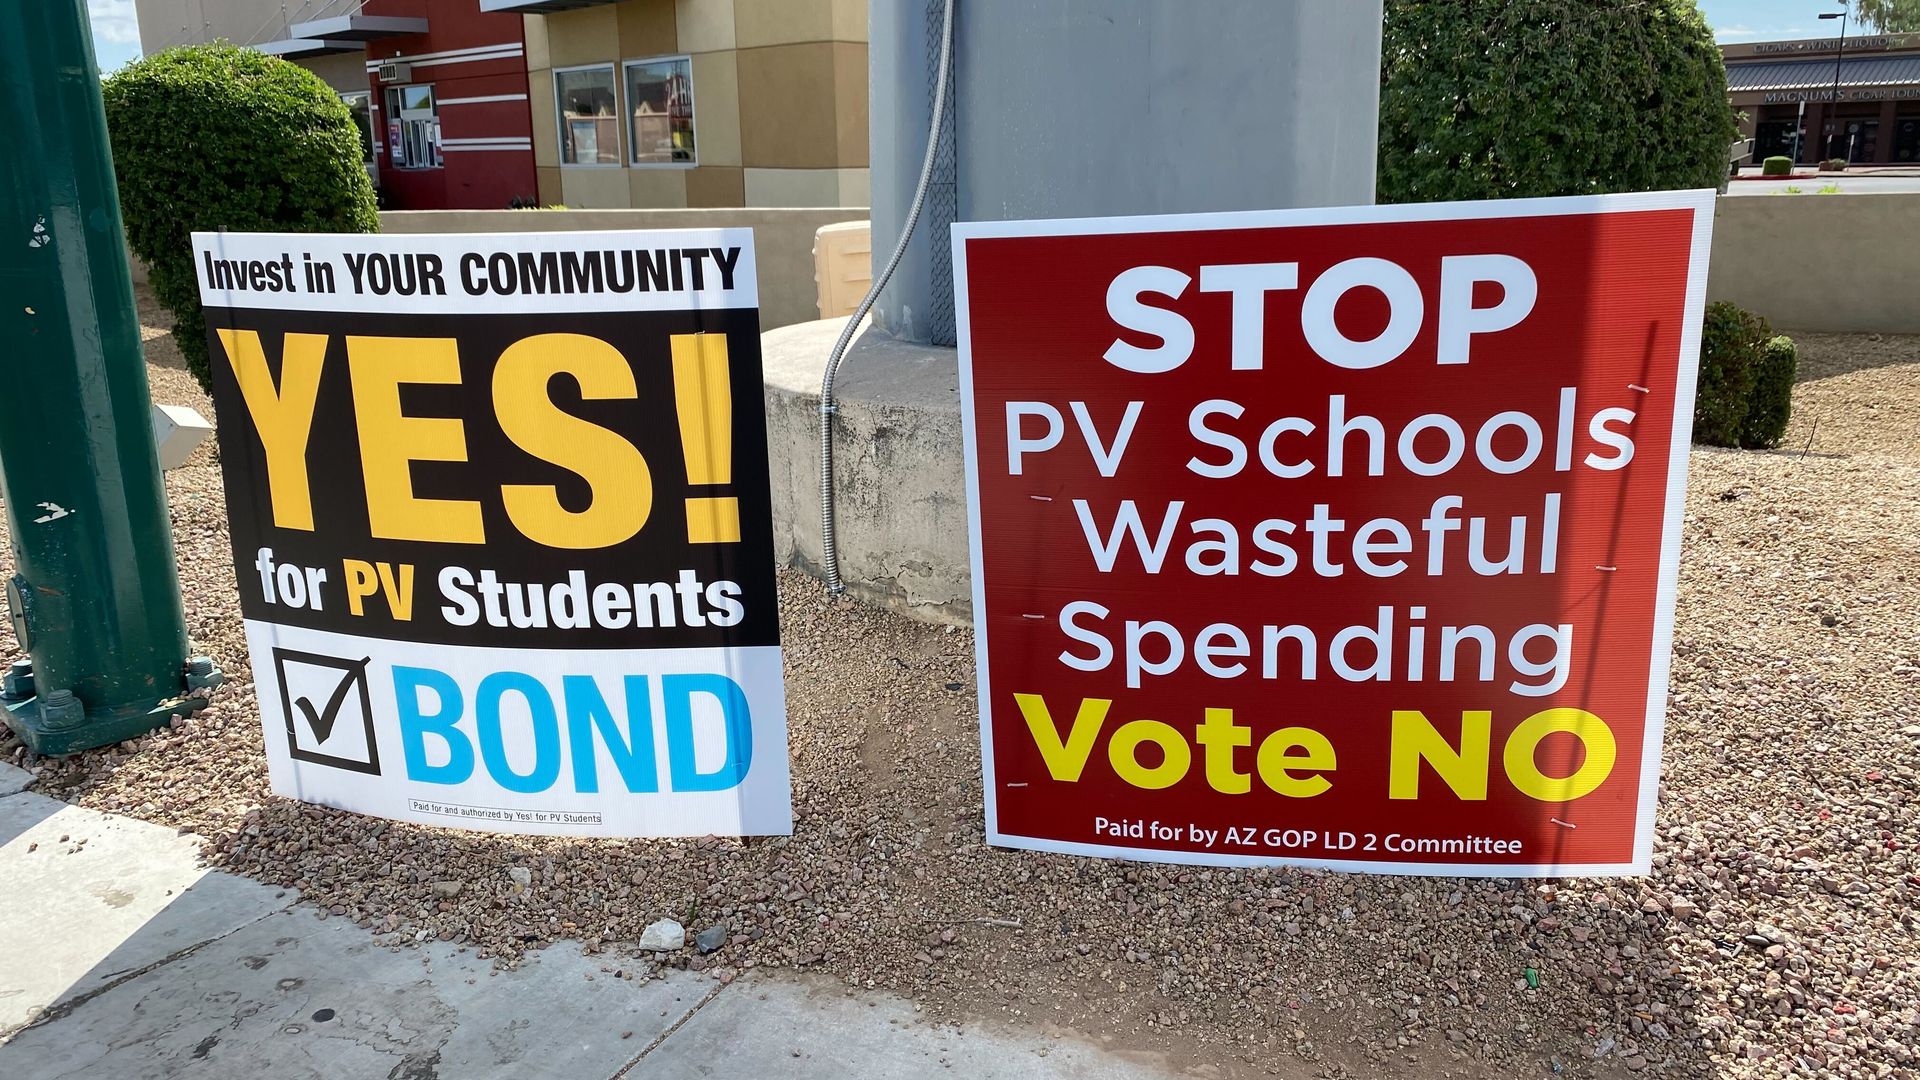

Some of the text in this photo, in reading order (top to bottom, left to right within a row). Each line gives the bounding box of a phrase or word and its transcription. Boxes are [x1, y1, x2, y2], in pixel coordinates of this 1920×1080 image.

[1850, 89, 1886, 100] CIGAR
[203, 246, 742, 297] Invest in YOUR COMMUNITY
[1103, 253, 1538, 374] STOP
[216, 329, 741, 549] YES!
[1006, 387, 1637, 479] PV Schools
[1072, 492, 1562, 579] Wasteful
[255, 547, 745, 631] for PV Students
[1058, 600, 1574, 697] Spending
[392, 665, 753, 794] BOND
[1013, 692, 1618, 803] Vote NO
[413, 801, 601, 823] Paid for and authorized by Yes! for PV Students
[1095, 816, 1523, 854] Paid for by AZ GOP LD 2 Committee
